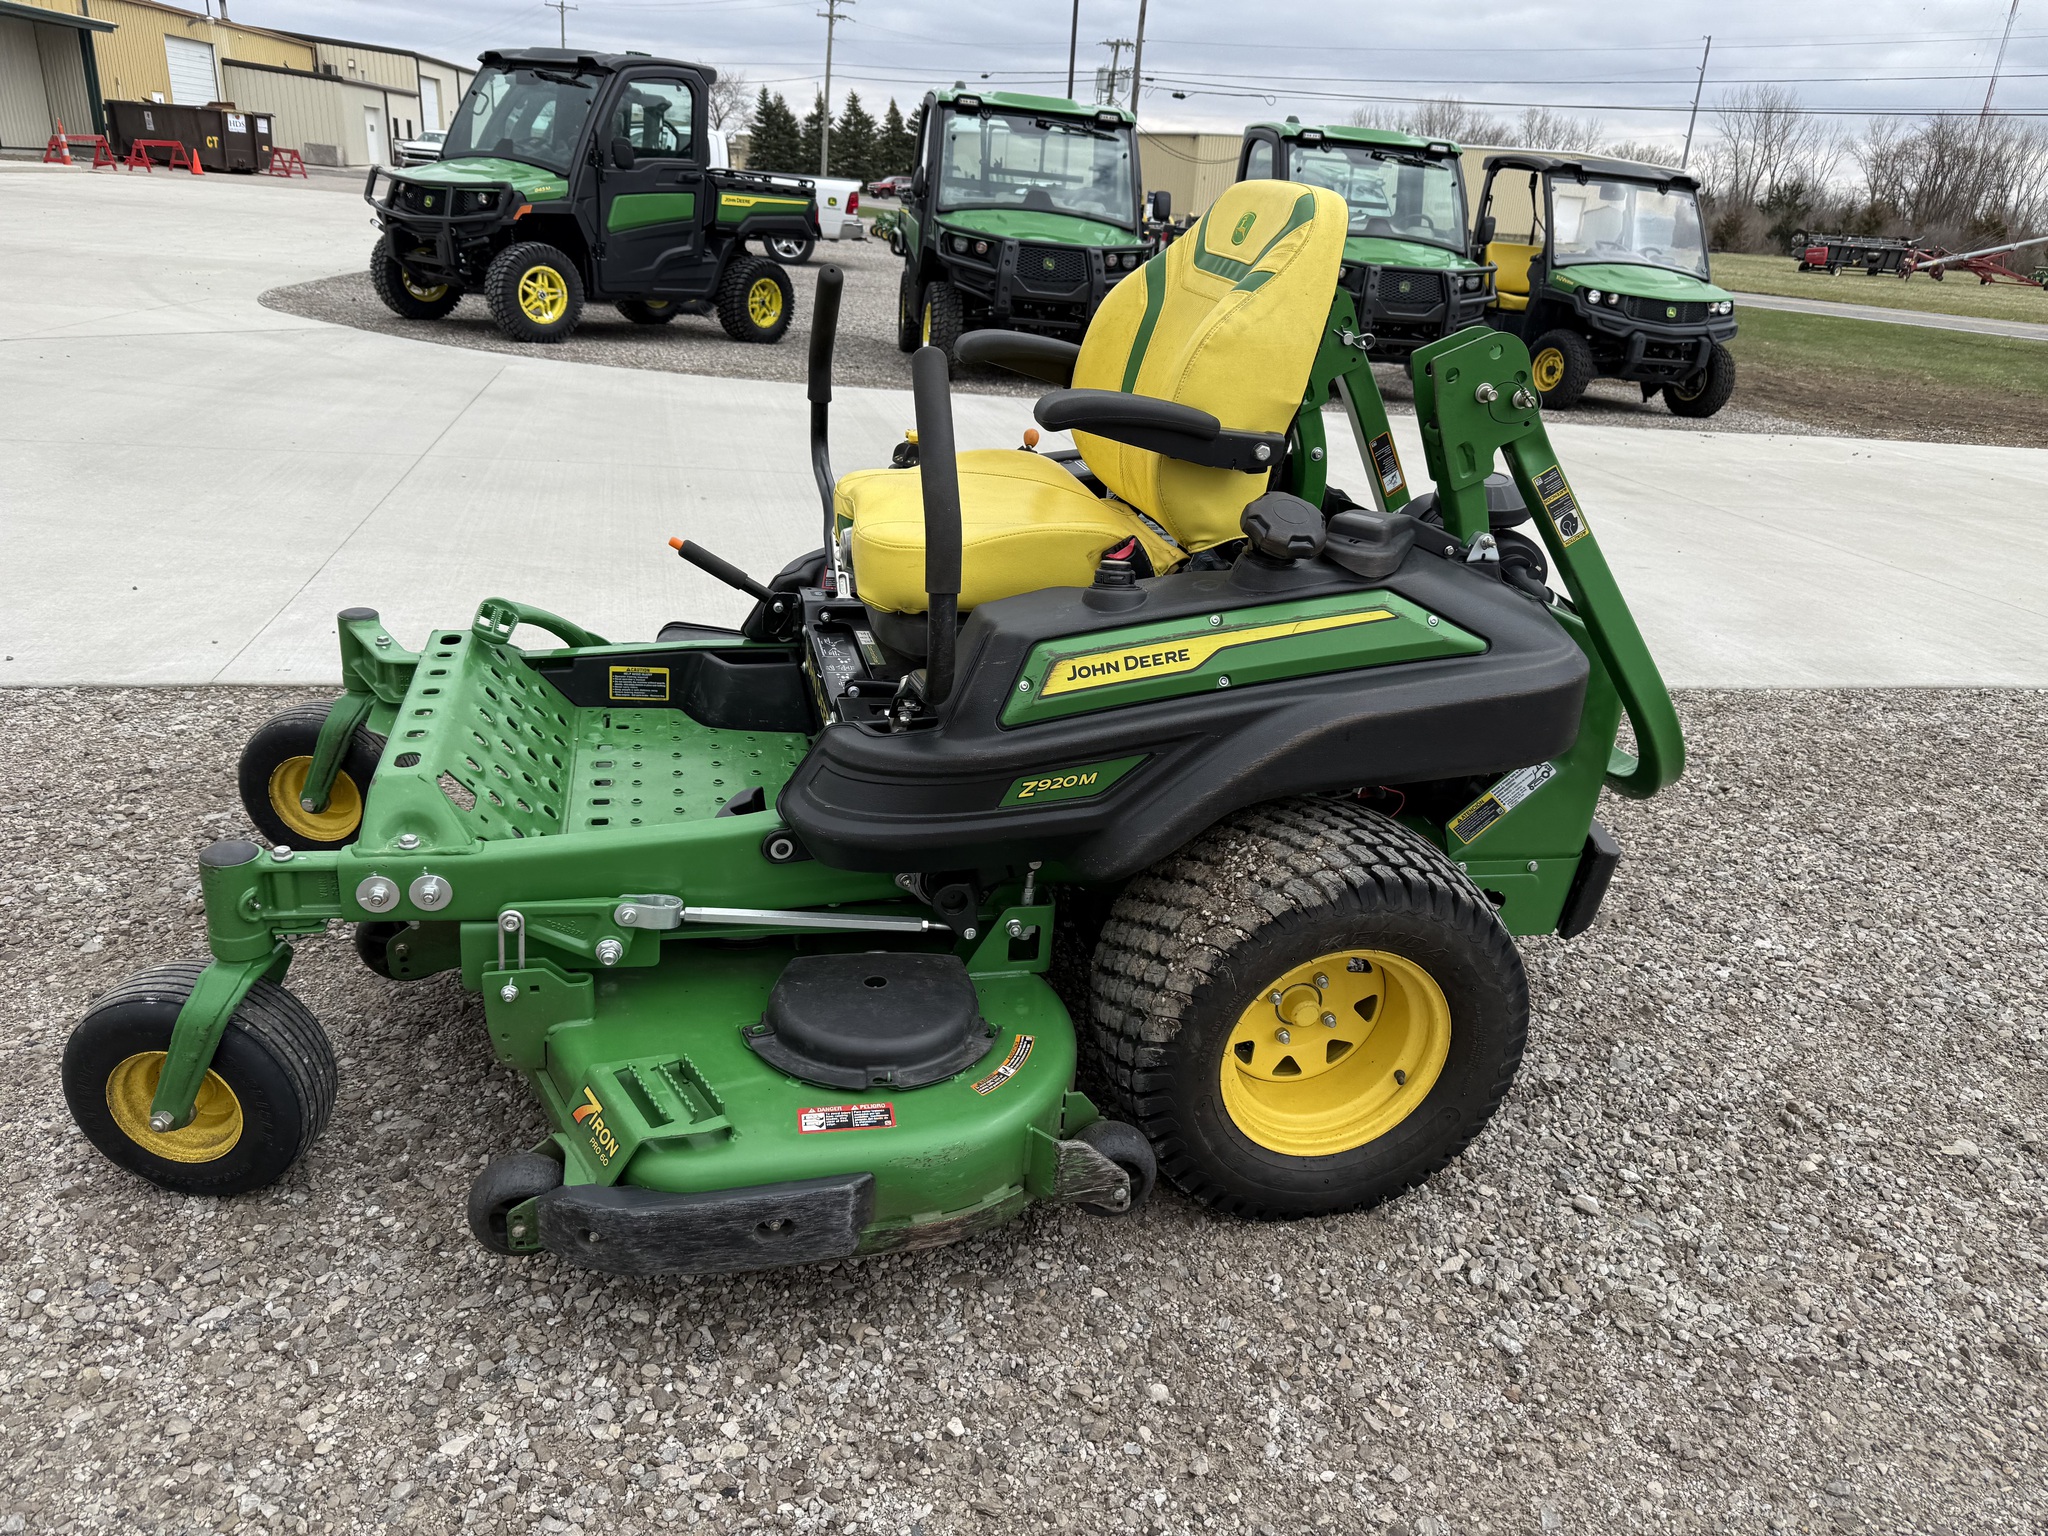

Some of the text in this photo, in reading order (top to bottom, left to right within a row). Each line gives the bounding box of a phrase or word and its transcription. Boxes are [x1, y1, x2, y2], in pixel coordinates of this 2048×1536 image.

[206, 136, 219, 149] CT
[1067, 648, 1191, 682] JOHN DEERE
[1017, 772, 1099, 799] Z920M
[589, 1137, 609, 1166] PRO 60
